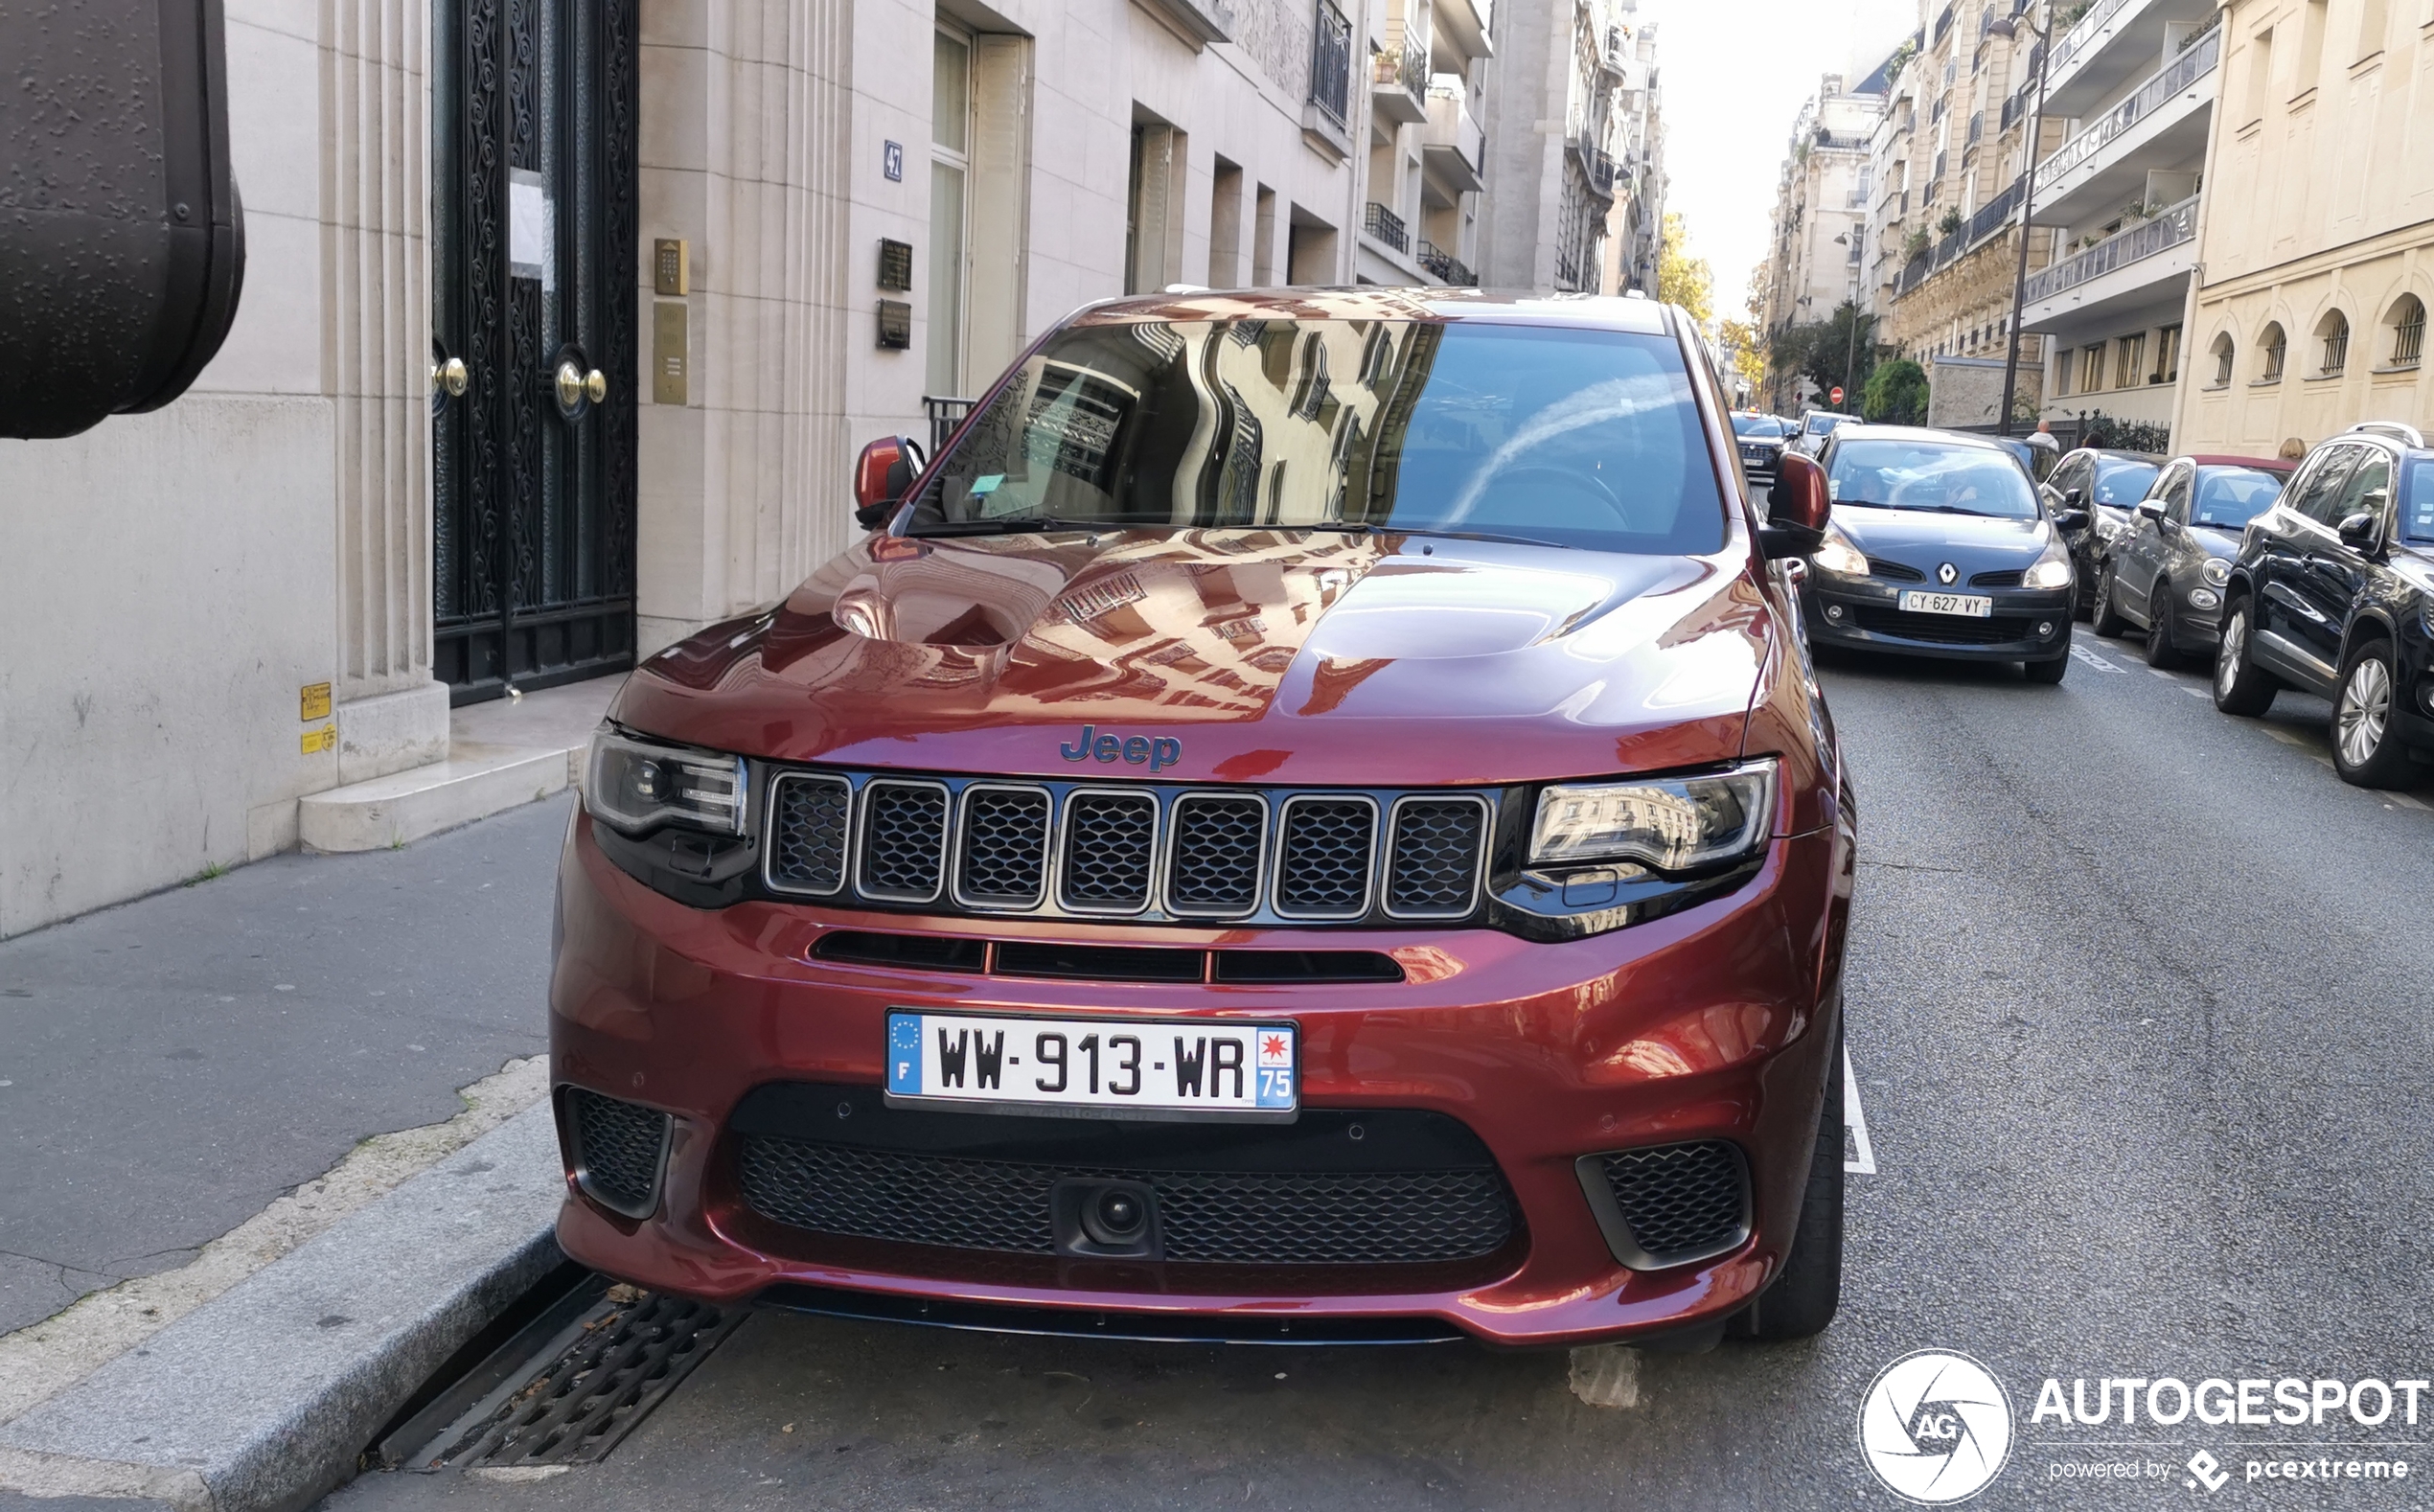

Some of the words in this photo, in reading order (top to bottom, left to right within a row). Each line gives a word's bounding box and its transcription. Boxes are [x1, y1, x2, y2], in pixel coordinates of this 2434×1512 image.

[887, 147, 900, 175] 47
[1060, 723, 1182, 773] Jeep
[898, 1062, 909, 1080] F
[937, 1027, 1244, 1098] WW-913-WR
[1260, 1069, 1291, 1097] 75
